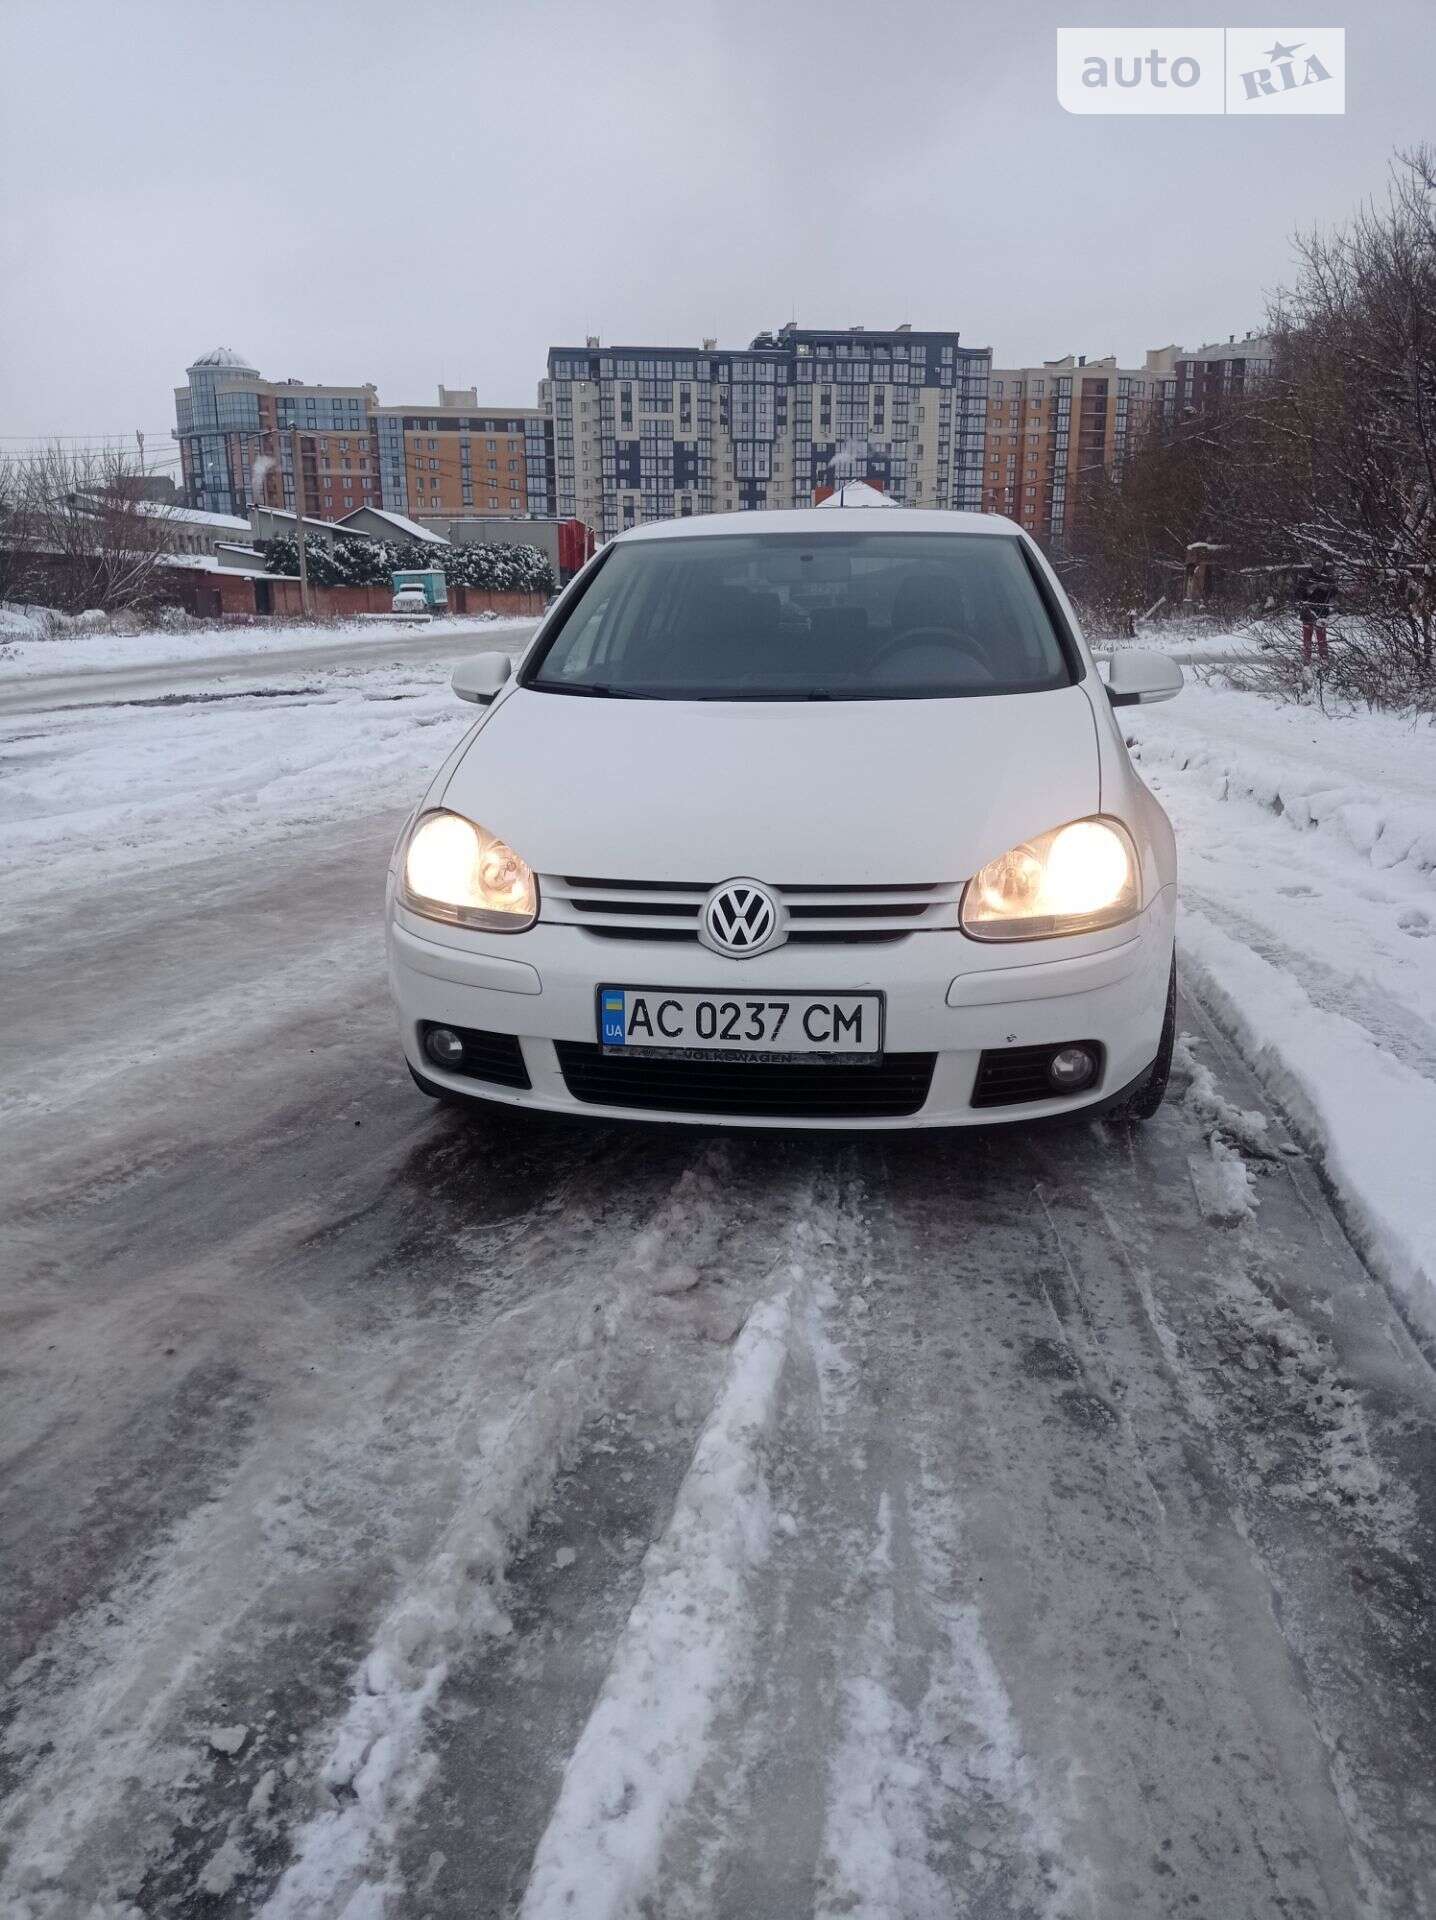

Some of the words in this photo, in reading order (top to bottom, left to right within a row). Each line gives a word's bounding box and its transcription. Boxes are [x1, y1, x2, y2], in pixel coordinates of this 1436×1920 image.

[709, 886, 773, 949] VW
[606, 1024, 623, 1037] UA
[627, 998, 684, 1038] AC
[695, 1001, 790, 1041] 0237
[802, 1003, 863, 1043] CM
